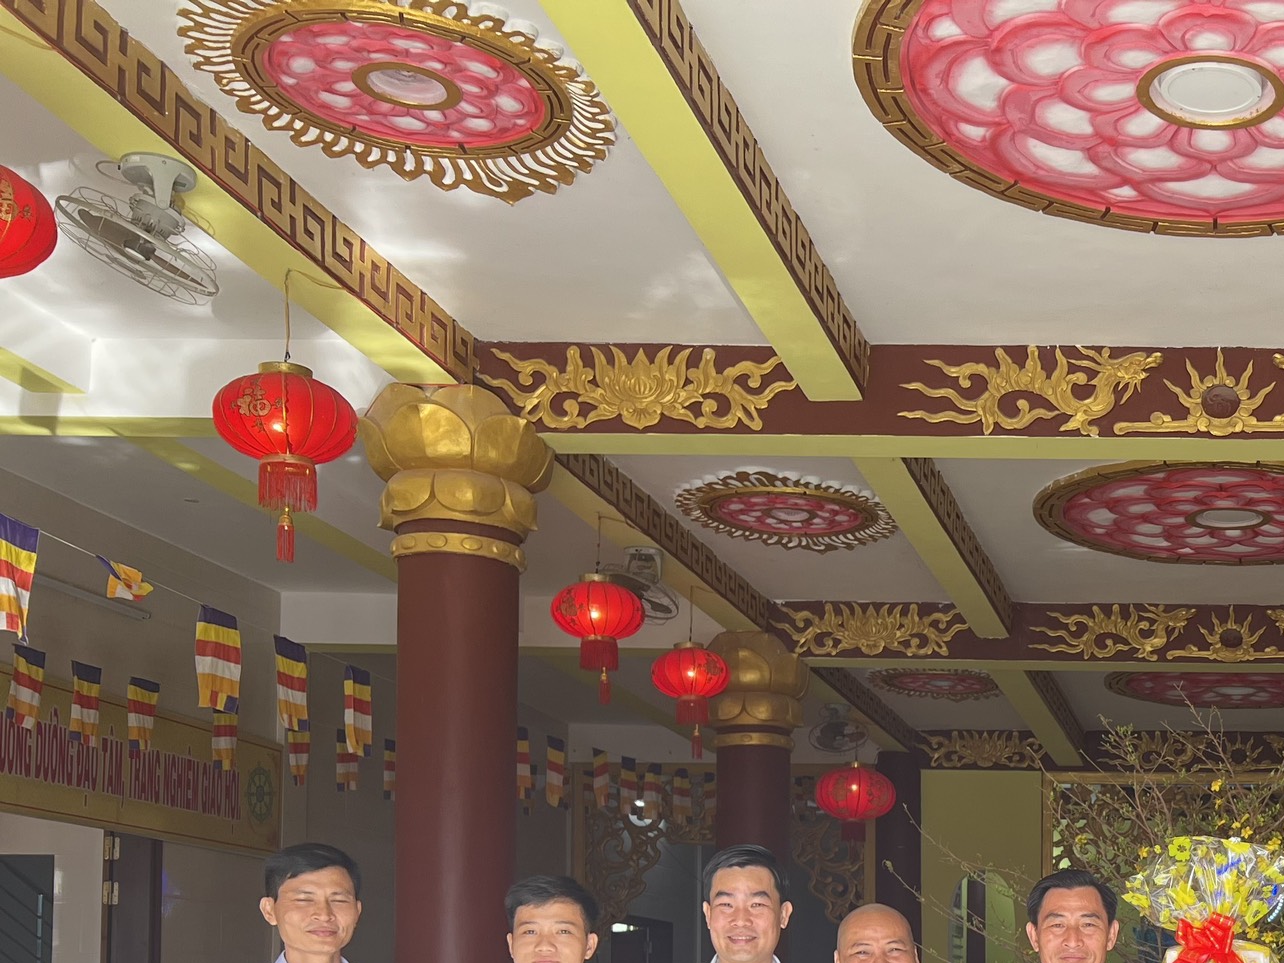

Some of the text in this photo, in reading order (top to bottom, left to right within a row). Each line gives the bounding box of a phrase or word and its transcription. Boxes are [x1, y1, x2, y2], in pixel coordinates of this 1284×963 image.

[102, 725, 125, 808] TÂM,
[128, 749, 161, 804] TRANG
[163, 746, 200, 812] NGHIÊM
